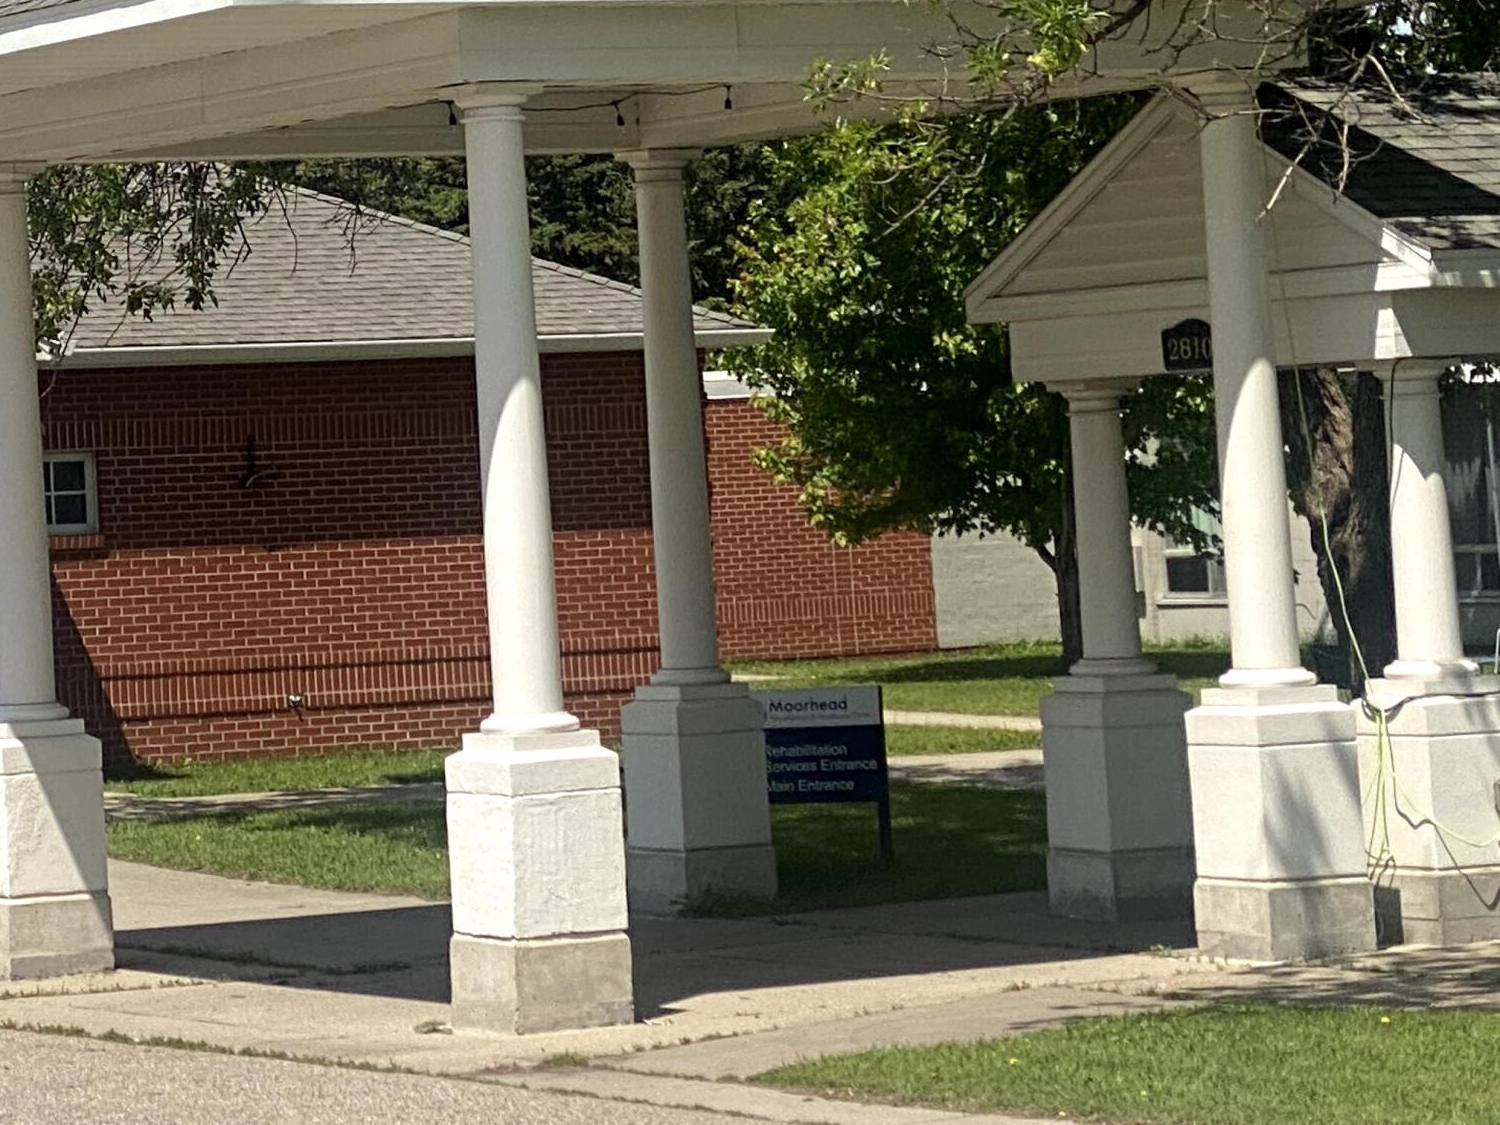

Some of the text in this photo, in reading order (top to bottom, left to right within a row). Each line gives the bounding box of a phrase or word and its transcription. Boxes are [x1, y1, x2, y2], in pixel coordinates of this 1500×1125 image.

[1169, 336, 1211, 361] 2810
[769, 696, 848, 712] Moorhead
[767, 744, 848, 757] Rehabilitation
[767, 758, 878, 773] Services Entrance
[798, 779, 855, 792] Entrance
